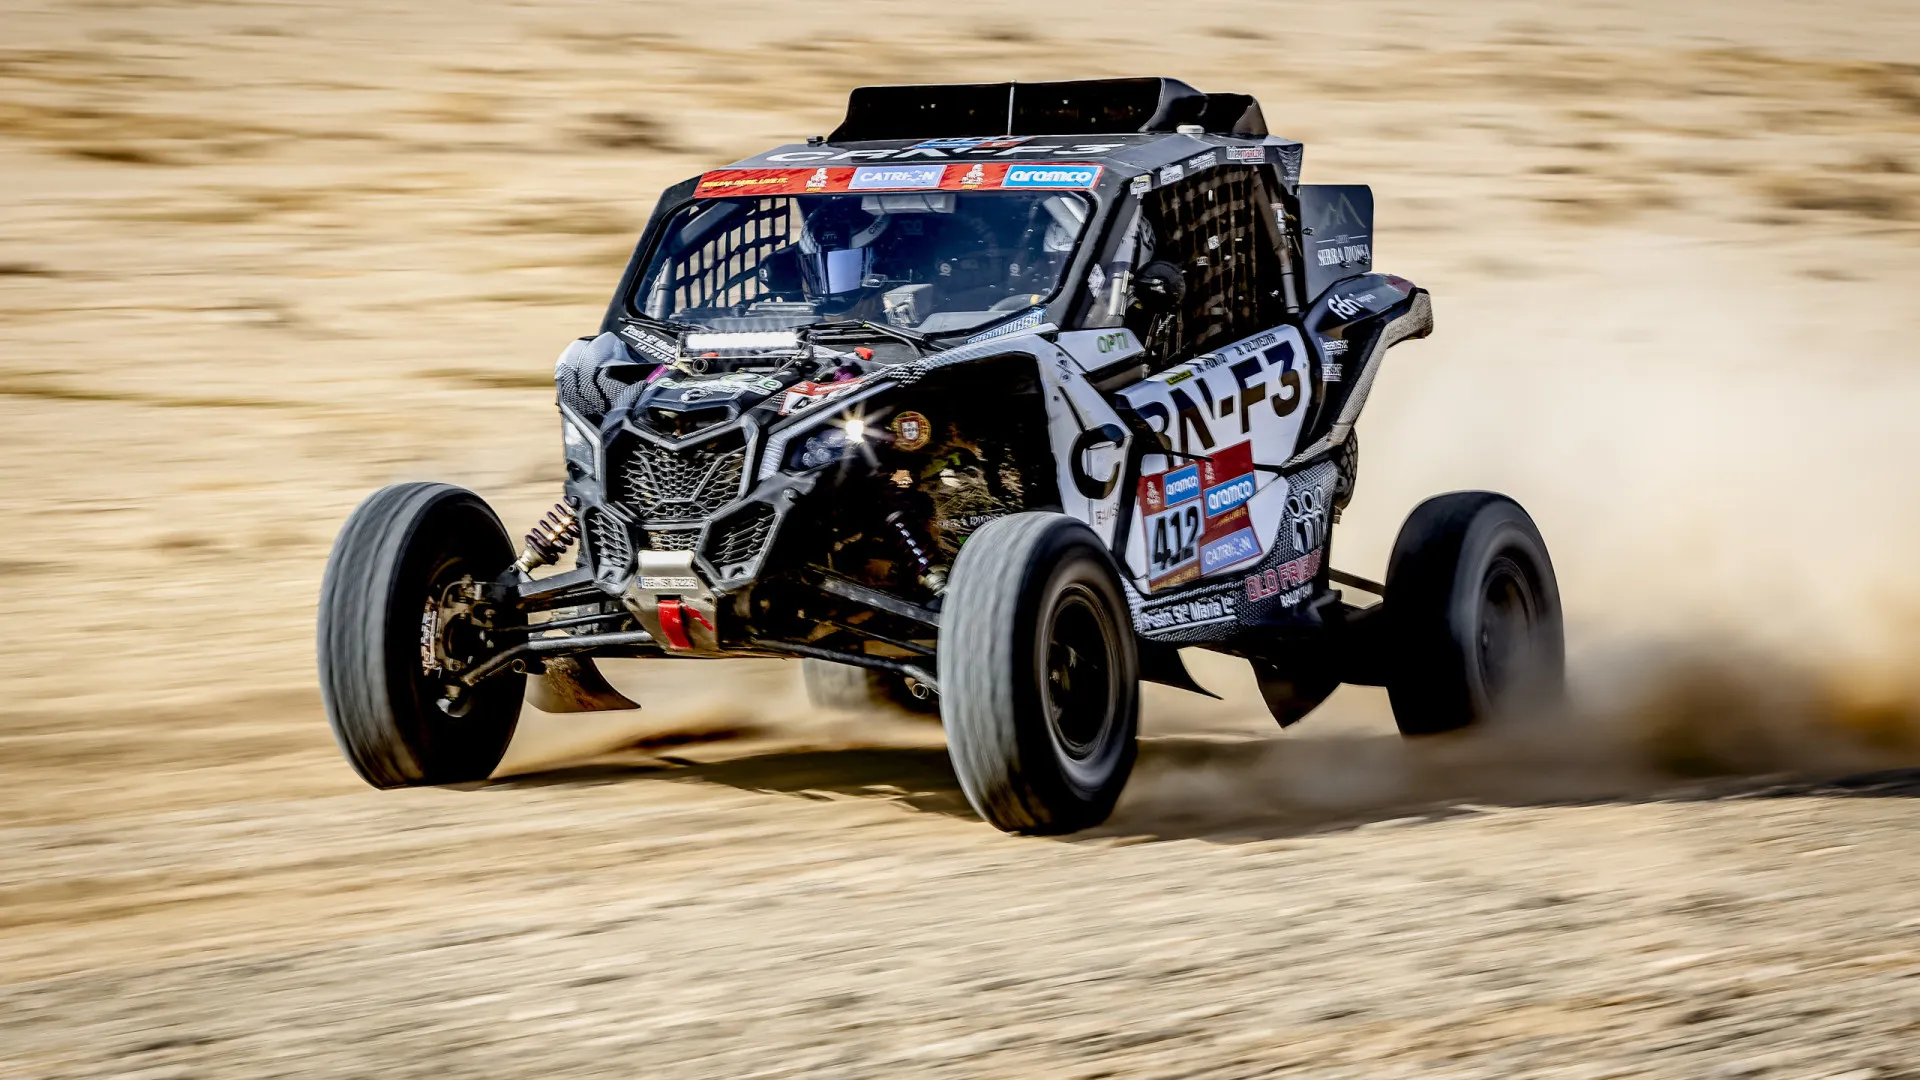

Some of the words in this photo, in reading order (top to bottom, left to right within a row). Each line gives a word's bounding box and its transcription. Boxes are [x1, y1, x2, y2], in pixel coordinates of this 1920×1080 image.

[1009, 169, 1093, 183] aramco
[1165, 474, 1199, 497] aramco
[1208, 480, 1253, 510] aramco
[1151, 505, 1200, 571] 412
